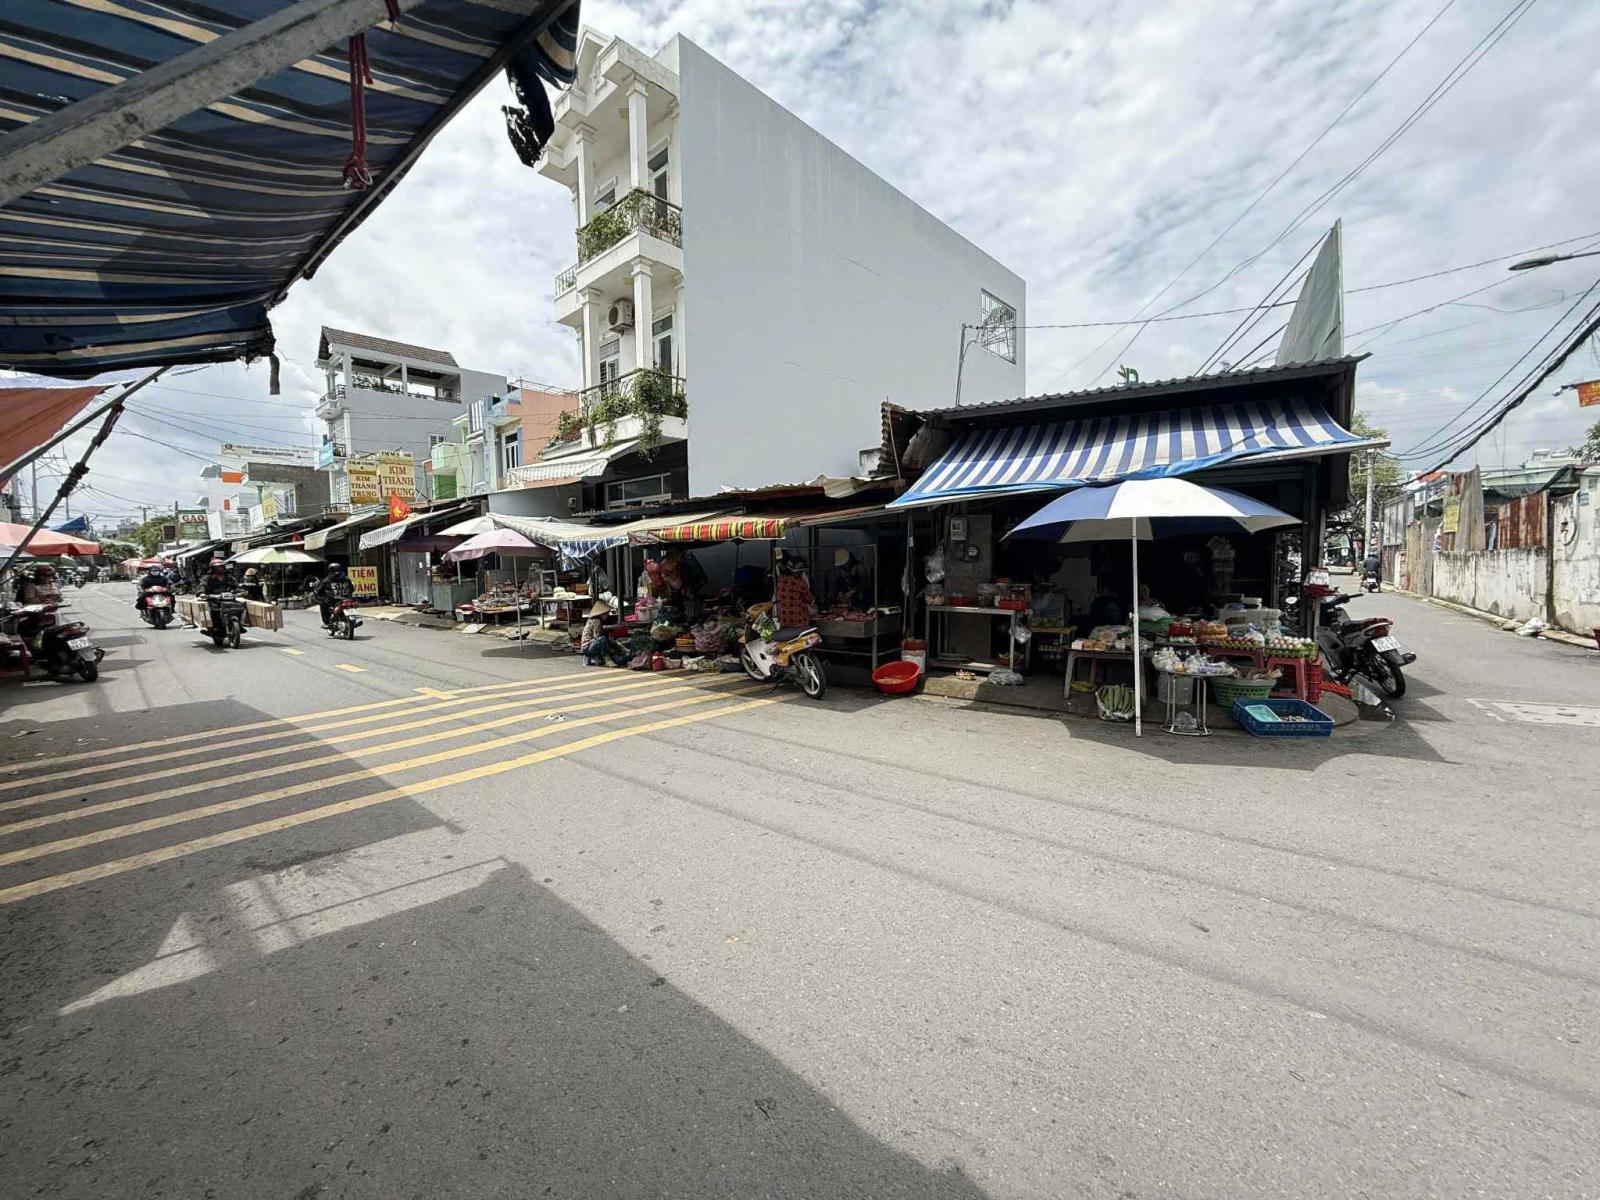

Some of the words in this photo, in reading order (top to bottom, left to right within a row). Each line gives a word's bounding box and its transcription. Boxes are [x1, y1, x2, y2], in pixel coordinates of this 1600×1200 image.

[388, 466, 407, 475] KIM
[382, 475, 414, 486] THÀNH
[351, 482, 377, 490] THÀNH
[384, 487, 415, 497] TRUNG
